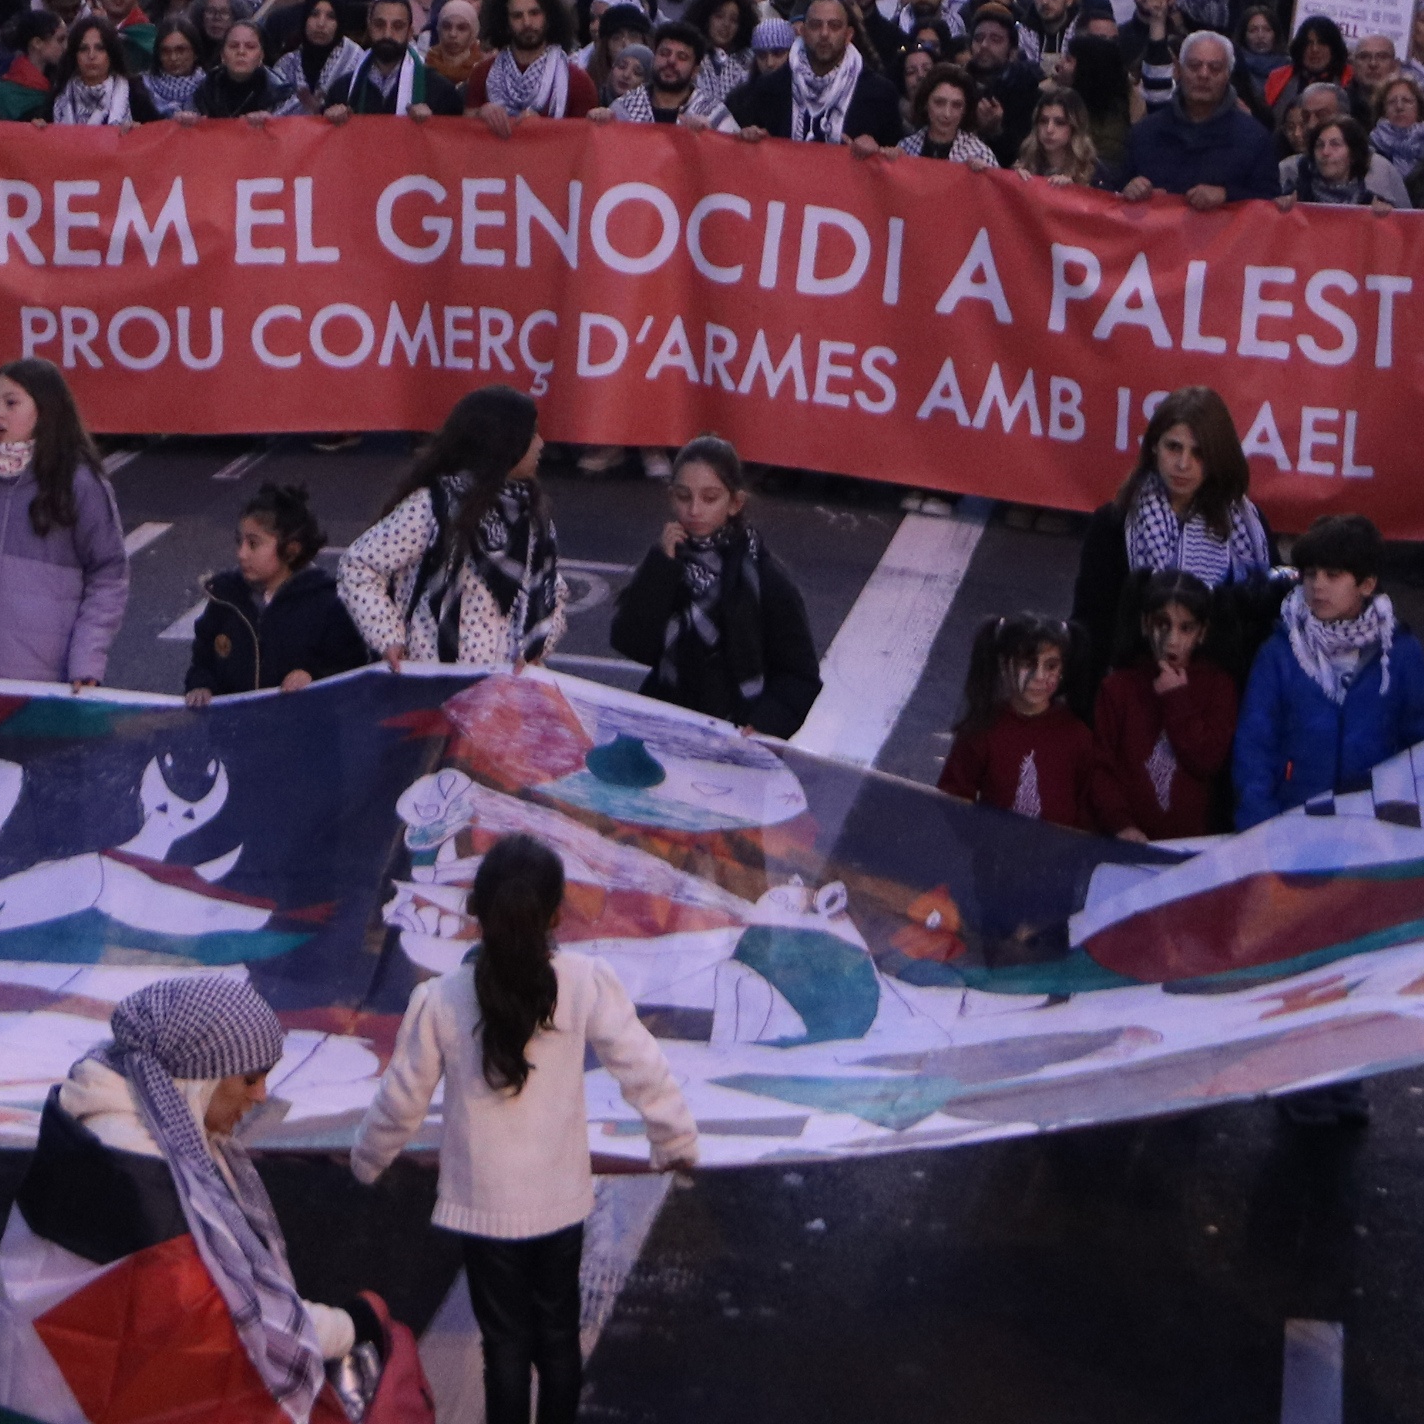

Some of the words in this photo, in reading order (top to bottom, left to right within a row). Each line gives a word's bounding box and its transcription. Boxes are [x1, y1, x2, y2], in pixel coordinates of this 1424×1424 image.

[234, 176, 340, 265] EL
[375, 174, 904, 305] GENOCIDI
[935, 227, 1013, 324] A
[21, 306, 224, 371] PROU
[251, 301, 557, 395] COMERÇ
[577, 312, 897, 414] D'ARMES
[916, 357, 1085, 441] AMB
[1115, 386, 1374, 478] IAEL
